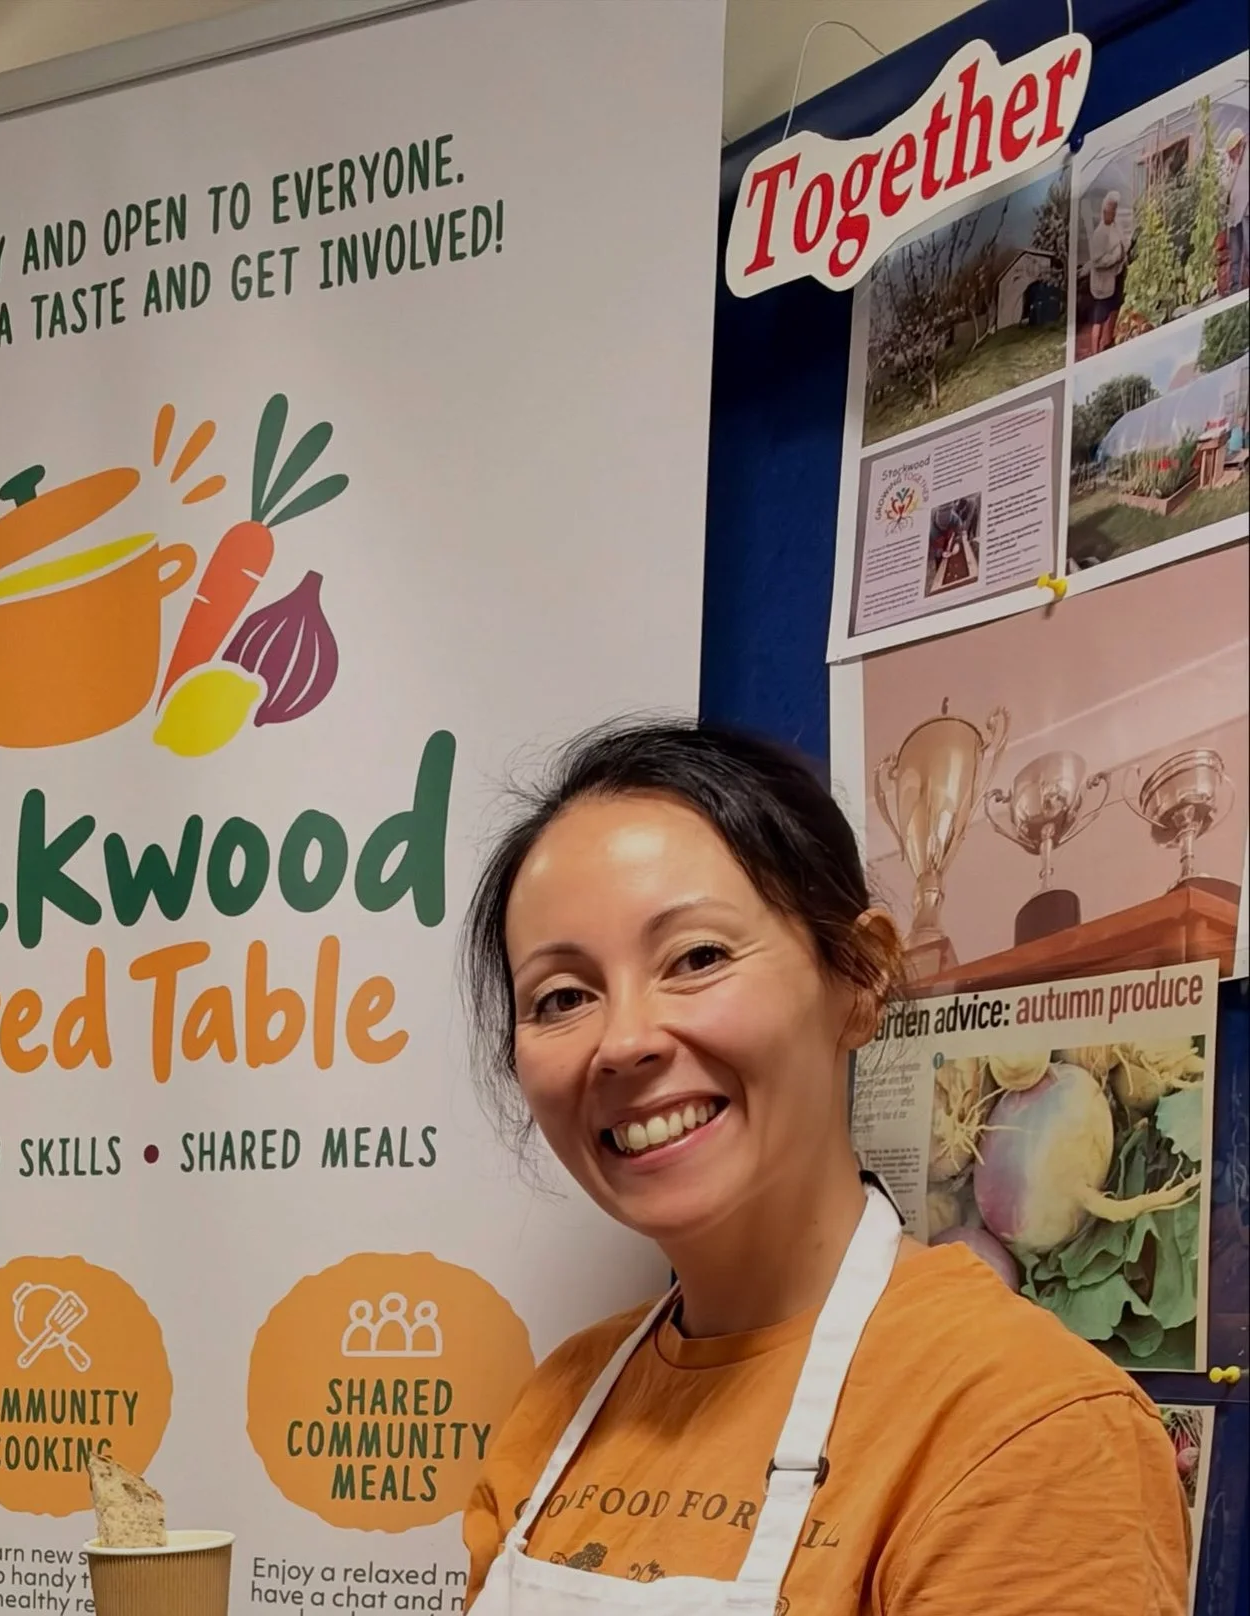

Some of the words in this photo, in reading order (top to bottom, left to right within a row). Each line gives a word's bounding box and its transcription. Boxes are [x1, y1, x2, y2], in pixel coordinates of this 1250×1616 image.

[744, 47, 1082, 278] Together
[22, 219, 86, 275] AND
[104, 193, 186, 256] OPEN
[208, 181, 250, 234] TO
[272, 134, 464, 224] EVERYONE.
[30, 277, 126, 340] TASTE
[143, 260, 211, 317] AND
[231, 246, 300, 301] GET
[319, 199, 503, 290] INVOLVED!
[129, 936, 410, 1084] Table
[875, 1006, 929, 1042] arden
[934, 994, 1010, 1034] advice:
[1016, 986, 1103, 1025] autumn
[1109, 973, 1203, 1024] produce
[19, 1136, 122, 1177] SKILLS
[180, 1128, 301, 1173] SHARED
[321, 1124, 437, 1168] MEALS
[326, 1378, 452, 1416] SHARED
[287, 1420, 491, 1460] COMMUNITY
[331, 1464, 438, 1502] MEALS
[576, 1484, 671, 1518] FOOD
[677, 1490, 758, 1530] FOR
[801, 1518, 840, 1549] LL
[12, 1564, 77, 1594] handy
[32, 1549, 73, 1564] new
[253, 1556, 315, 1586] Enjoy
[321, 1567, 335, 1582] a
[343, 1561, 437, 1585] relaxed
[251, 1580, 304, 1605] have
[310, 1591, 325, 1606] a
[332, 1585, 388, 1609] chat
[394, 1588, 443, 1611] and
